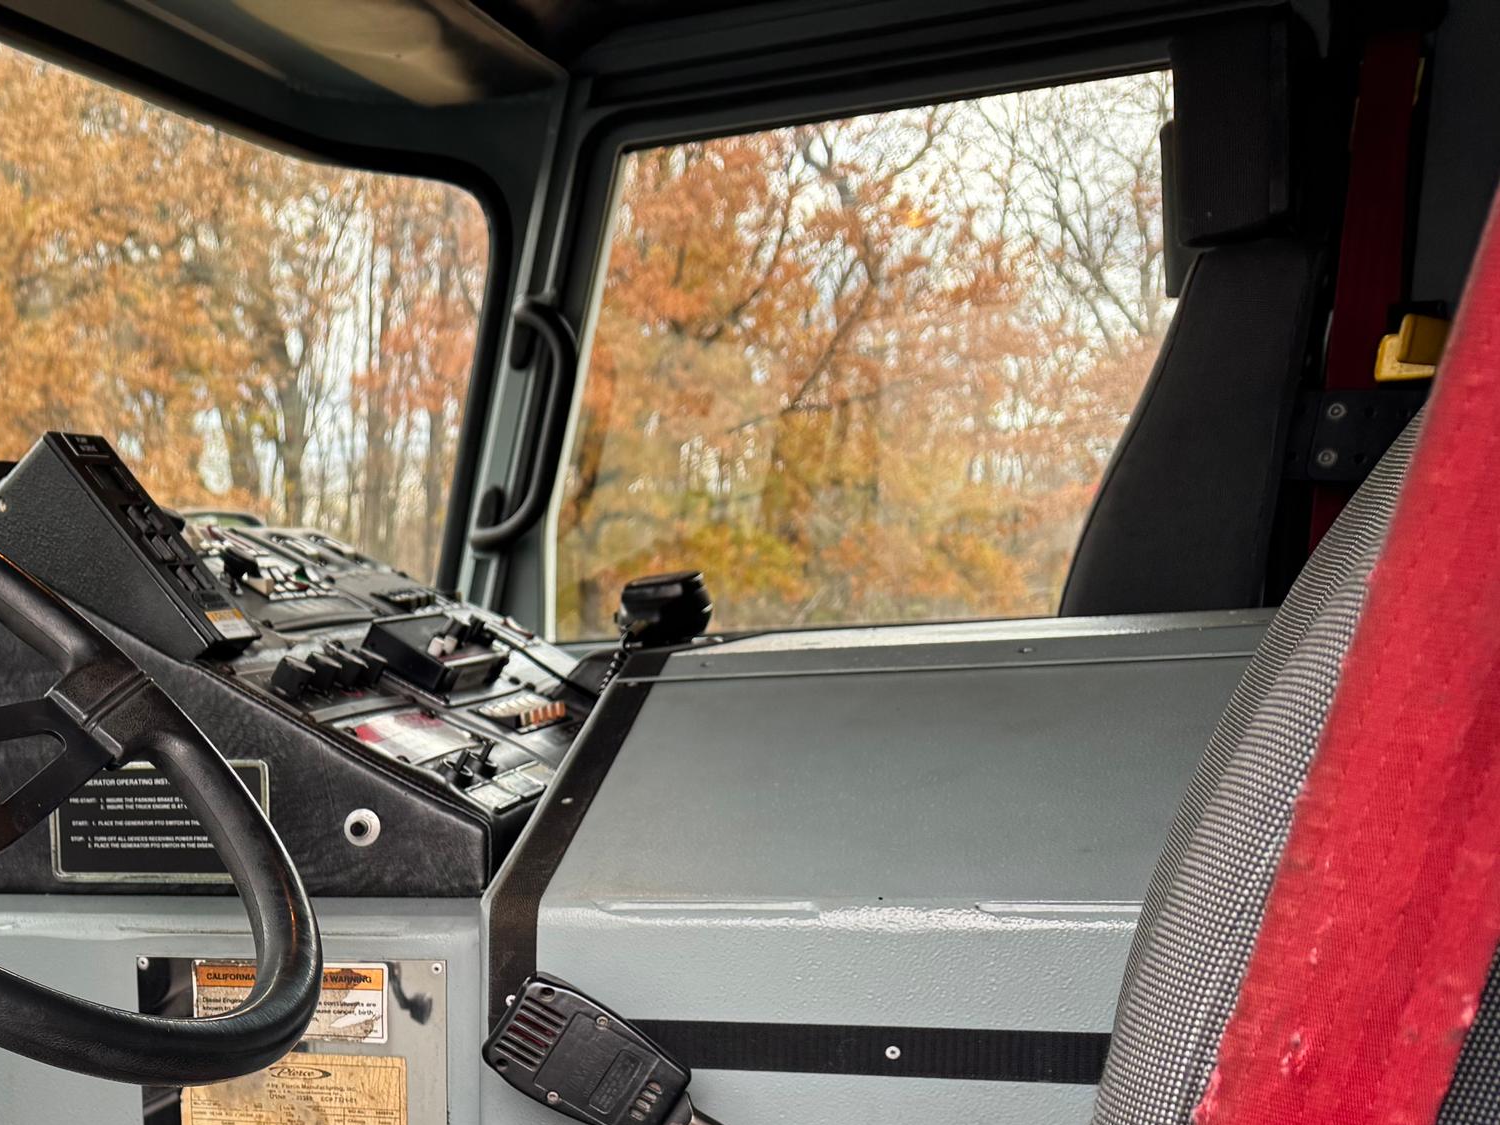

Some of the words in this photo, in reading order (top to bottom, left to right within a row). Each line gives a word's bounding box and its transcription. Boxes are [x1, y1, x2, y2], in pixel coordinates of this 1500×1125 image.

[116, 777, 153, 786] OPERATING
[206, 972, 256, 982] CALIFORNIA
[330, 974, 372, 984] WARNING
[277, 1067, 315, 1078] Pierce
